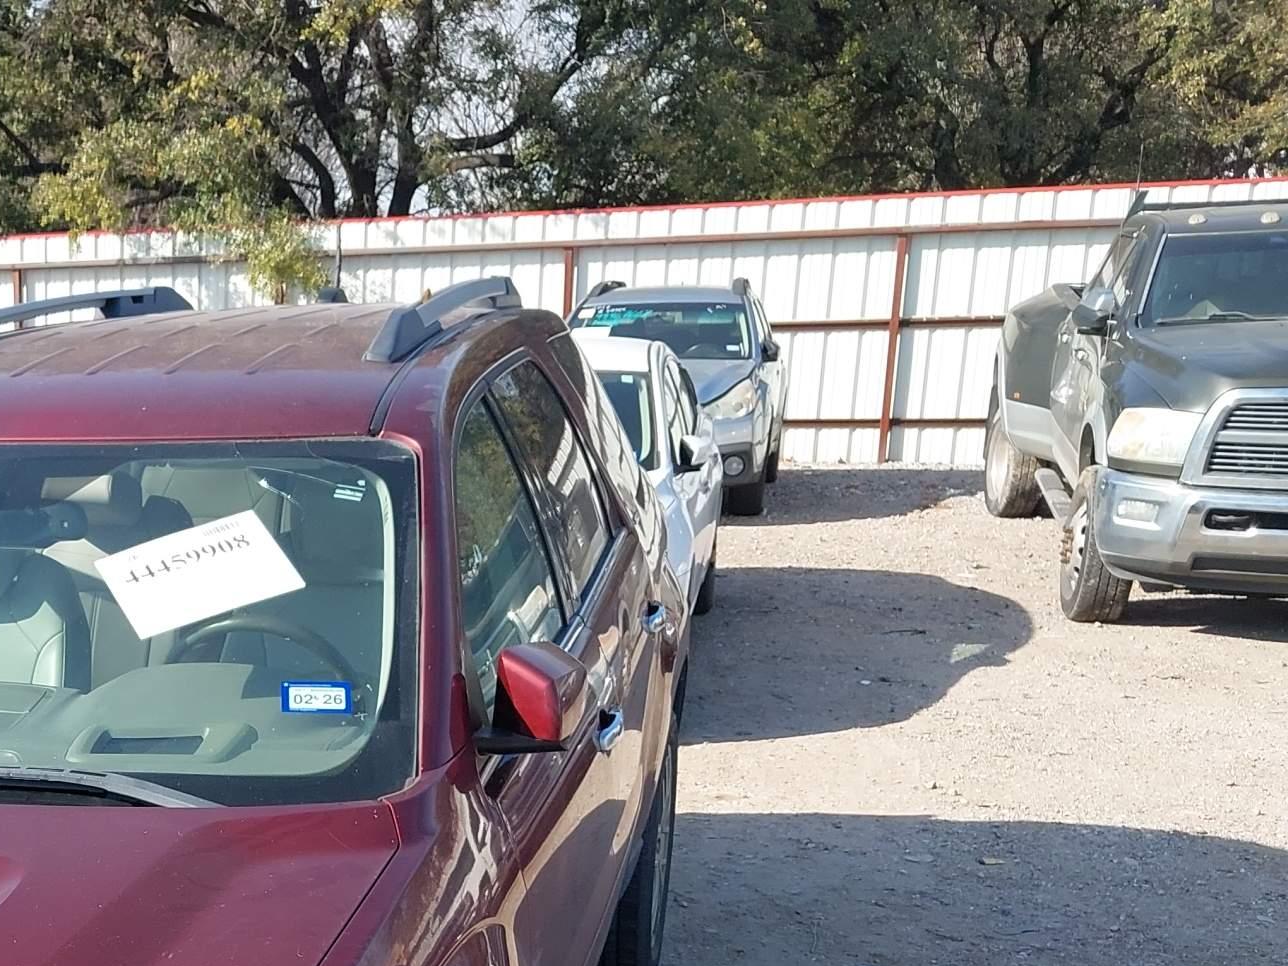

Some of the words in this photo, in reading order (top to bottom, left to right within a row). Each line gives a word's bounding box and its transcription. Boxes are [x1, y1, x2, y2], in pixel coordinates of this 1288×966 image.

[124, 533, 250, 584] 44459908
[293, 693, 313, 705] 02
[322, 693, 343, 705] 26
